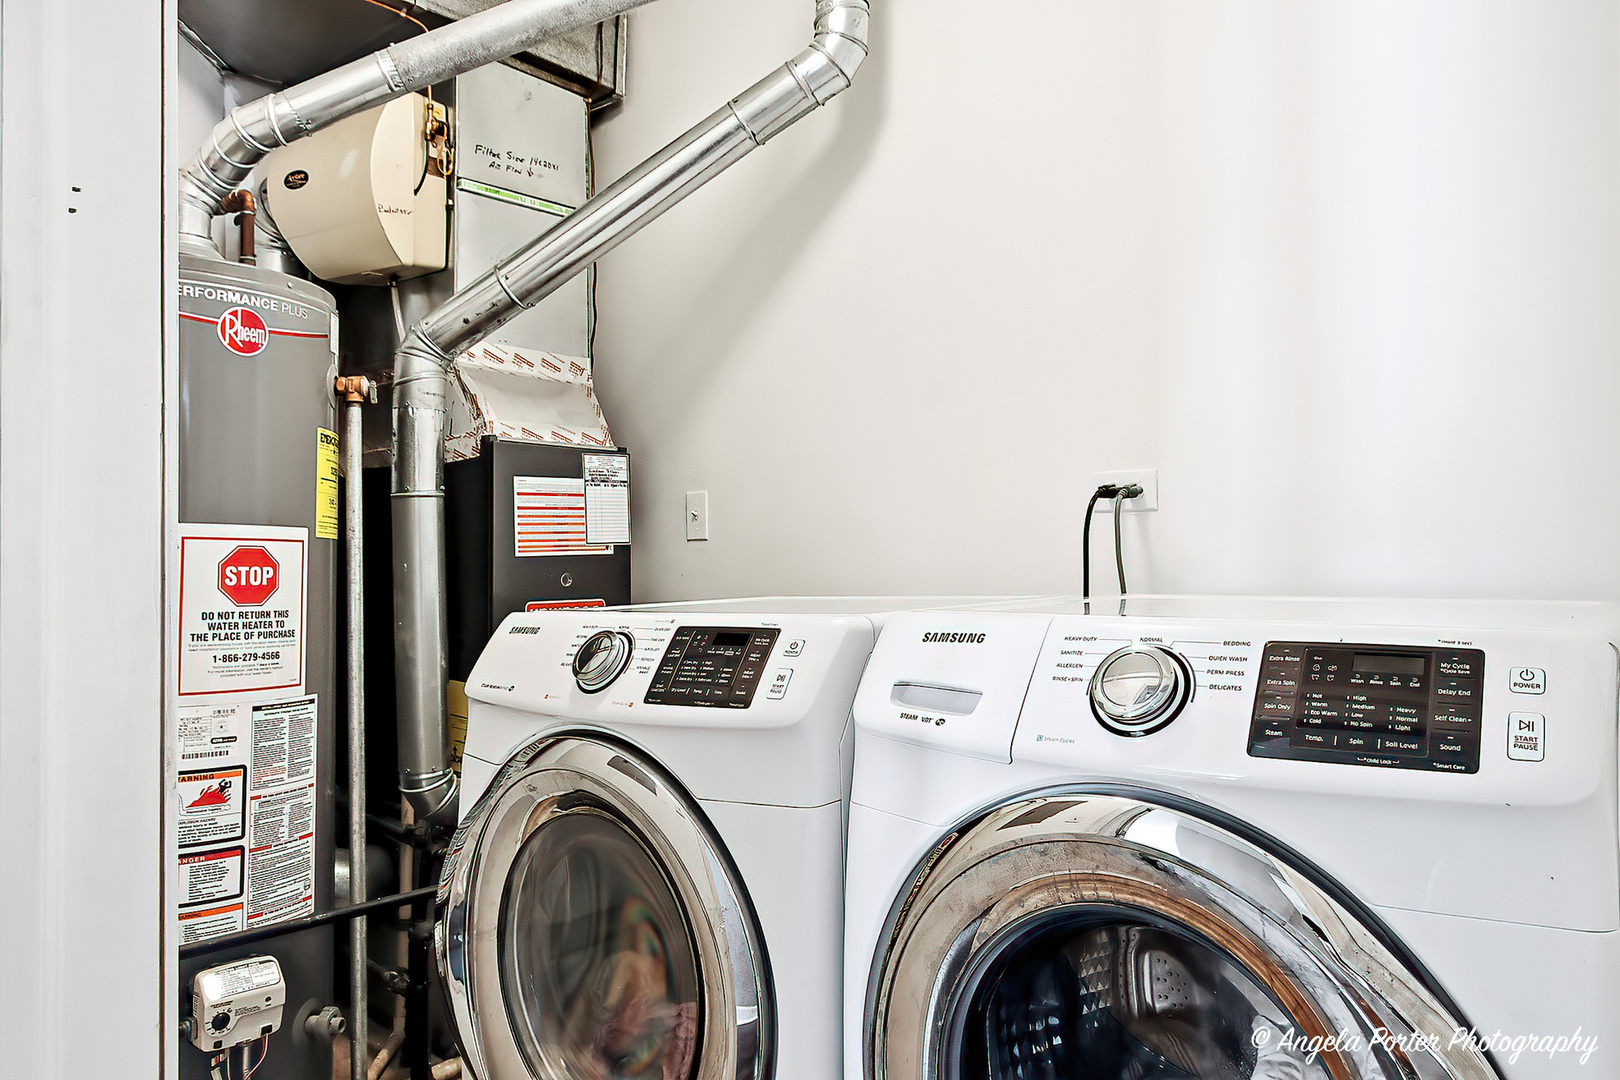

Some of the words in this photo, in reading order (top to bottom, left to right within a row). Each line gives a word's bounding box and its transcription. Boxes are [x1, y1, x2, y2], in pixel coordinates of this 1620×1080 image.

[178, 285, 279, 311] ERFORMANCE
[281, 304, 308, 319] PLUS
[225, 308, 265, 347] Rheem
[224, 565, 274, 586] STOP
[201, 611, 215, 621] DO
[217, 611, 236, 620] NOT
[238, 610, 271, 620] RETURN
[273, 609, 290, 619] THIS
[207, 621, 240, 631] WATER
[242, 620, 273, 630] HEATER
[275, 619, 285, 629] TO
[508, 626, 541, 635] SAMSUNG
[190, 633, 209, 642] THE
[212, 631, 241, 641] PLACE
[244, 631, 255, 640] OF
[257, 629, 296, 639] PURCHASE
[922, 632, 986, 643] SAMSUNG
[212, 651, 281, 664] 1-866-279-4566
[1208, 684, 1243, 692] DELICATES
[1513, 681, 1541, 690] POWER
[1437, 689, 1457, 697] Delay
[1263, 702, 1277, 710] Spin
[1277, 703, 1292, 711] Only
[1351, 703, 1376, 711] Medium
[1396, 706, 1417, 714] Heavy
[900, 712, 919, 721] STEAM
[1395, 715, 1419, 723] Normal
[1434, 714, 1448, 722] Self
[1394, 724, 1411, 732] Light
[1265, 729, 1283, 737] Steam
[1305, 734, 1324, 742] Temp.
[1348, 737, 1364, 746] Spin
[1514, 735, 1539, 743] START
[1385, 740, 1398, 748] Soil
[1399, 742, 1419, 750] Level
[1439, 743, 1461, 752] Sound
[1514, 743, 1539, 751] PAUSE
[179, 773, 215, 783] ARNING
[178, 856, 206, 865] ANGER
